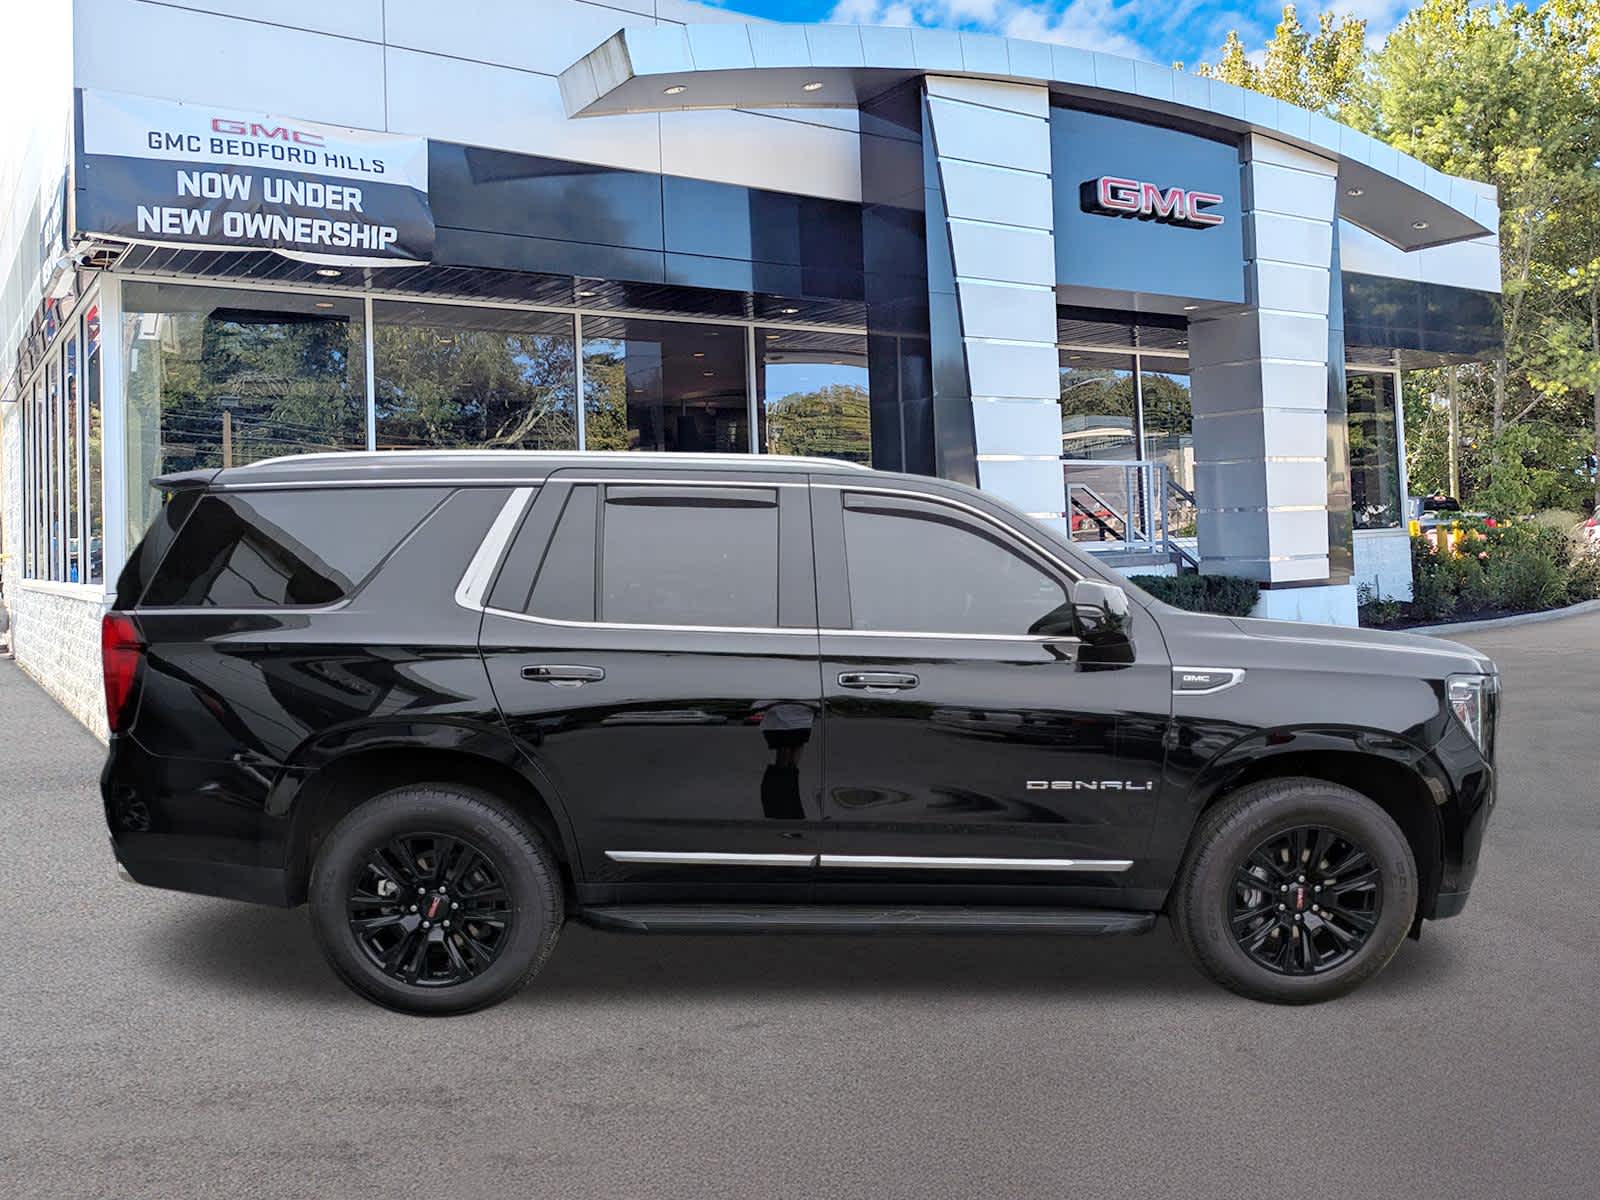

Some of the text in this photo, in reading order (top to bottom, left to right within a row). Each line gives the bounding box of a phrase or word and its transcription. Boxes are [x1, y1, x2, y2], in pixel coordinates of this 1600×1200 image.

[147, 131, 386, 174] GMC BEDFORD HILLS
[210, 118, 326, 149] GMC
[176, 170, 364, 213] NOW UNDER
[1096, 175, 1226, 225] GMC
[136, 205, 399, 251] NEW OWNERSHIP
[1183, 674, 1210, 682] GMC
[1026, 780, 1153, 790] DENALI
